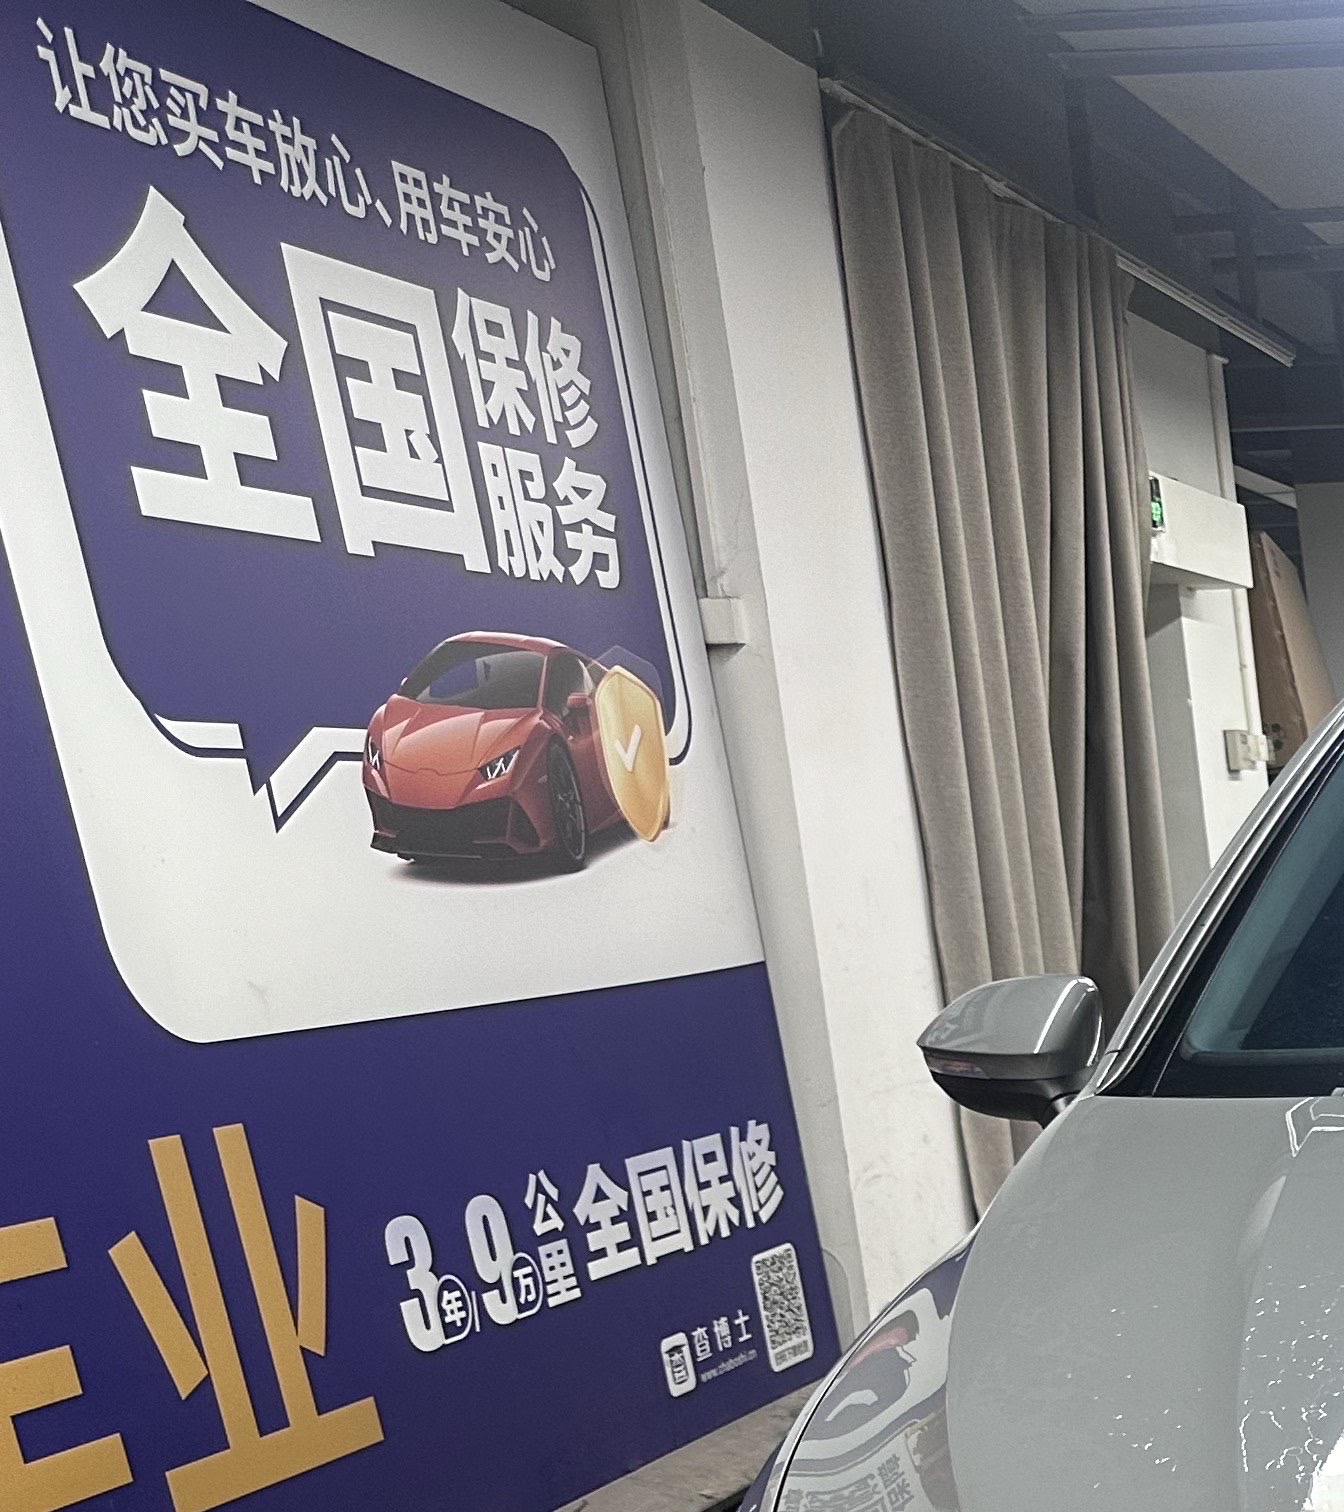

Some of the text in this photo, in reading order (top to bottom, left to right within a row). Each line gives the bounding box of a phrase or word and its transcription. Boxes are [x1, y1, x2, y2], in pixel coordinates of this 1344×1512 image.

[35, 18, 556, 283] 让您买车放心、用车安心
[73, 185, 491, 575] 全国
[451, 288, 600, 449] 保修
[478, 442, 621, 589] 服务
[691, 1309, 752, 1362] 查博士
